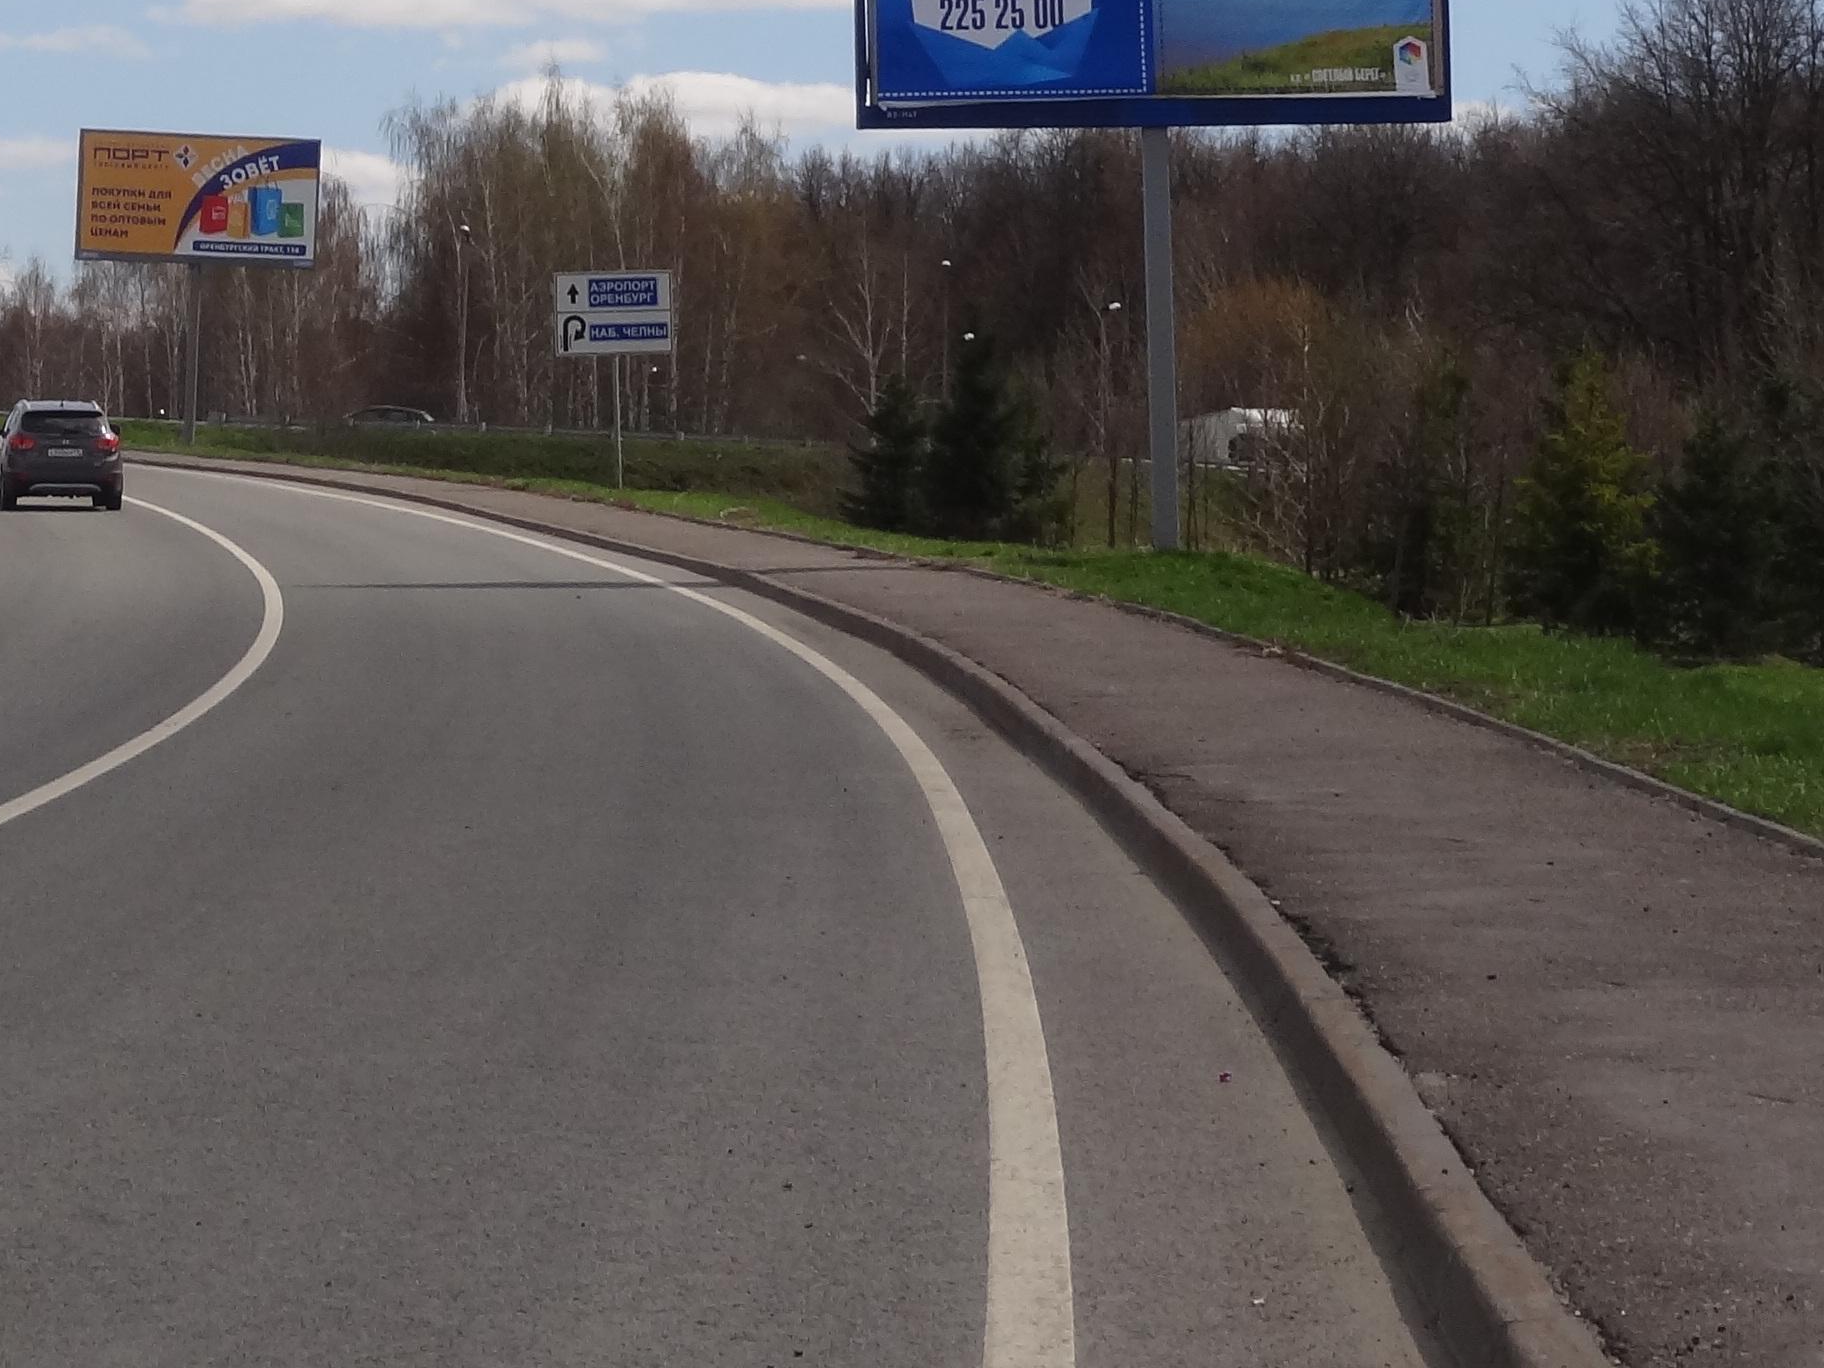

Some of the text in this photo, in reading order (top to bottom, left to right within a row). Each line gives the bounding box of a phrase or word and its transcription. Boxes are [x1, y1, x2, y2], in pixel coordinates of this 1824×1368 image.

[94, 147, 170, 162] ПОРТ
[192, 145, 249, 189] ВЕСНА
[220, 155, 280, 190] ЗОВЁТ
[92, 187, 172, 200] ПОКУПКИ ДЛЯ
[91, 199, 161, 212] ВСЕЙ СЕМЬИ
[91, 214, 166, 226] ПО ОПТОВЫМ
[90, 227, 129, 238] ЦЕНАМ
[590, 280, 656, 292] АЭРОПОРТ
[590, 292, 654, 304] ОРЕНБУРГ
[591, 325, 667, 338] НАБ. ЧЕЛНЫ
